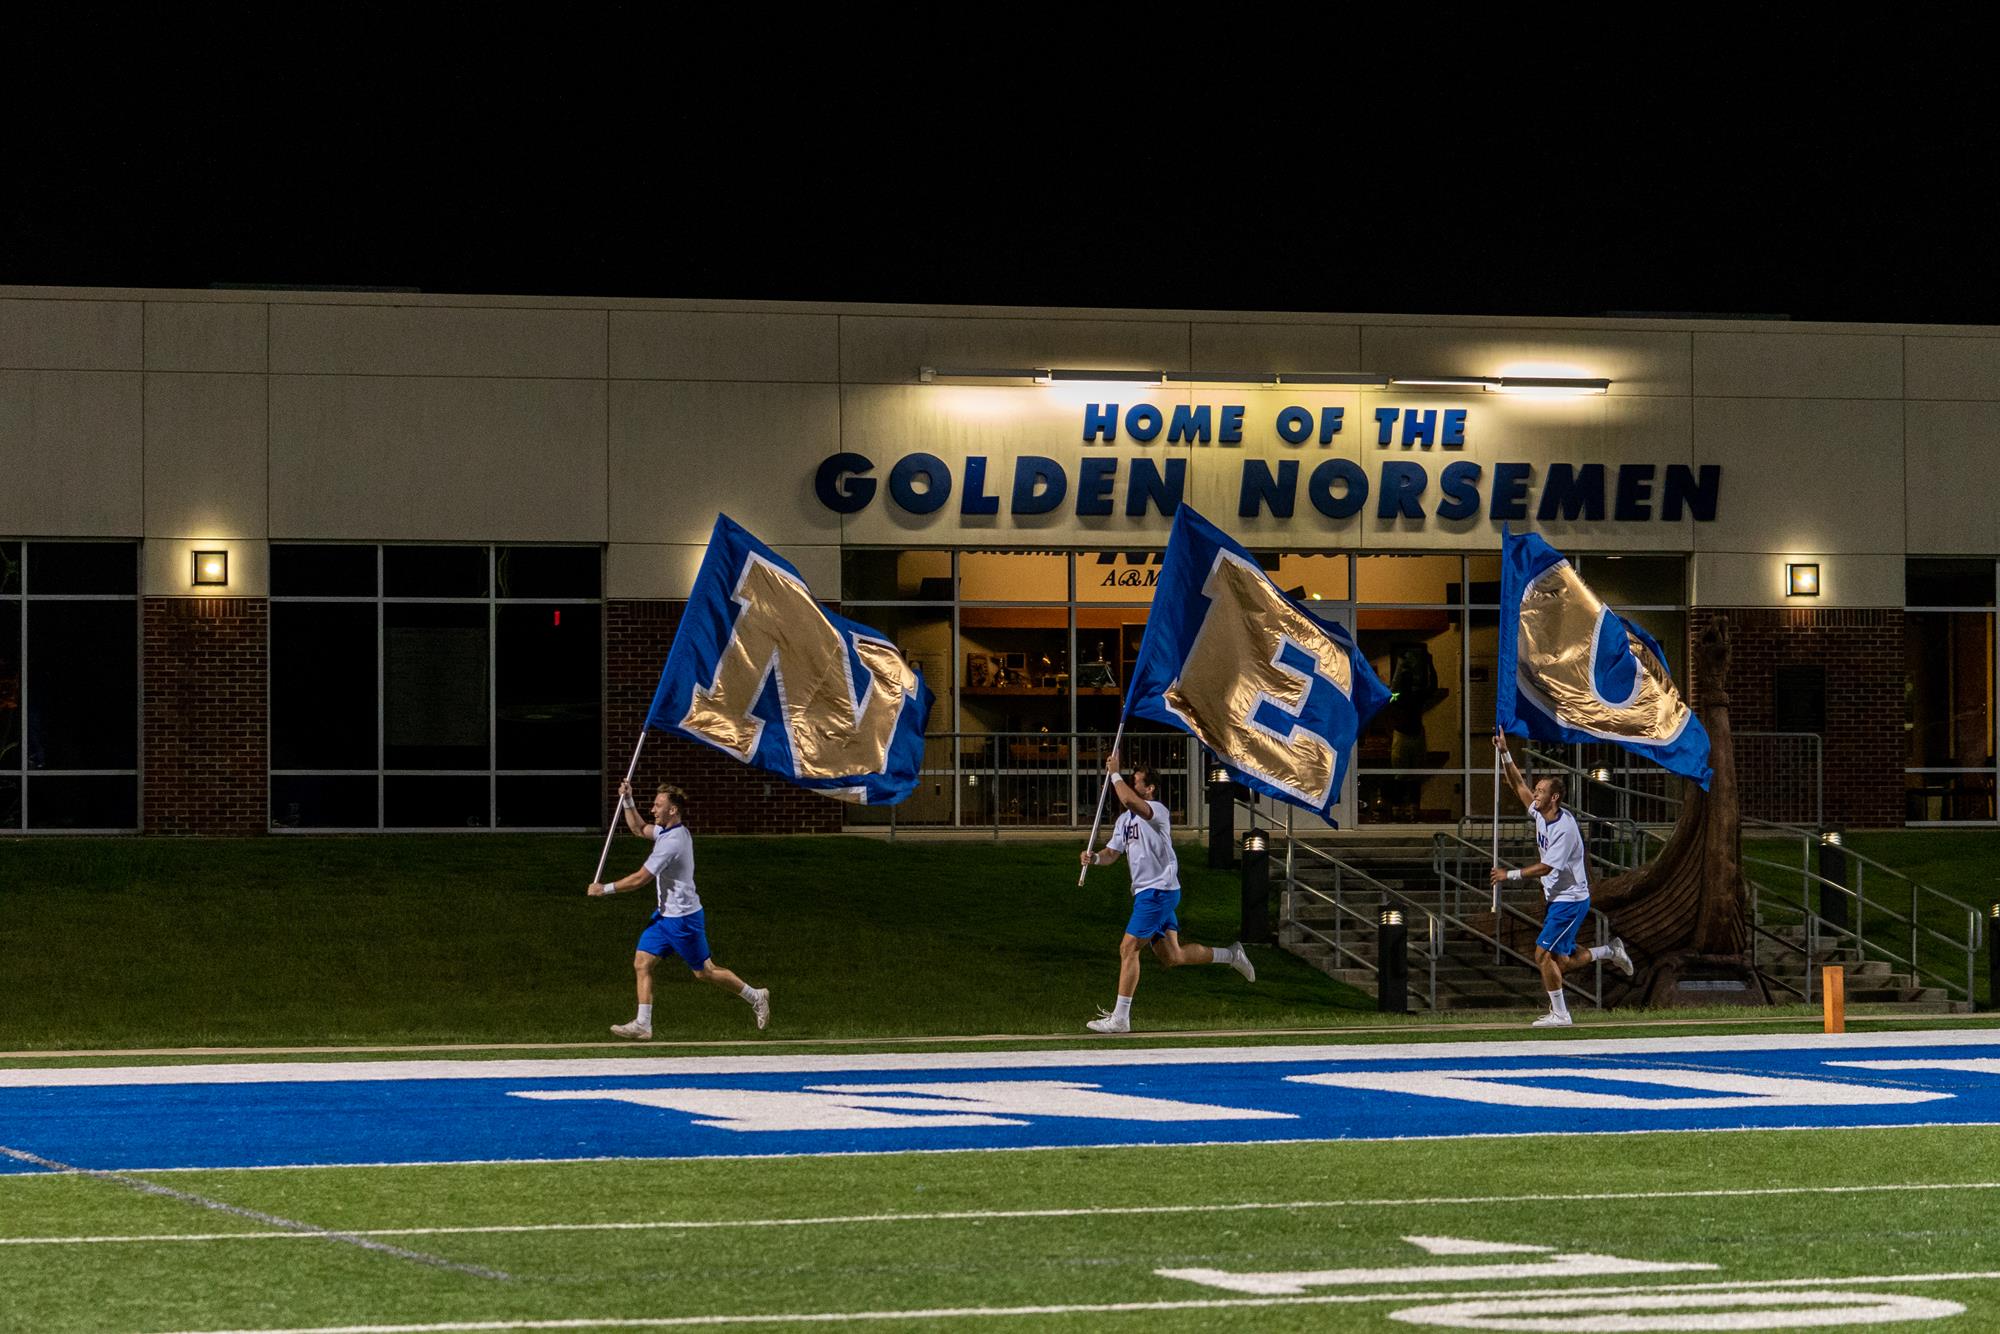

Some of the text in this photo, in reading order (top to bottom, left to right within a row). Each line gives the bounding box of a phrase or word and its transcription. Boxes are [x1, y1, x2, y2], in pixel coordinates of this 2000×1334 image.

[1083, 403, 1467, 447] HOME OF THE
[814, 452, 1722, 522] GOLDEN NORSEMEN
[1100, 569, 1162, 587] A&M
[678, 550, 920, 780] N
[1165, 547, 1353, 809] E
[1122, 822, 1139, 843] NEO
[1537, 831, 1549, 851] NE
